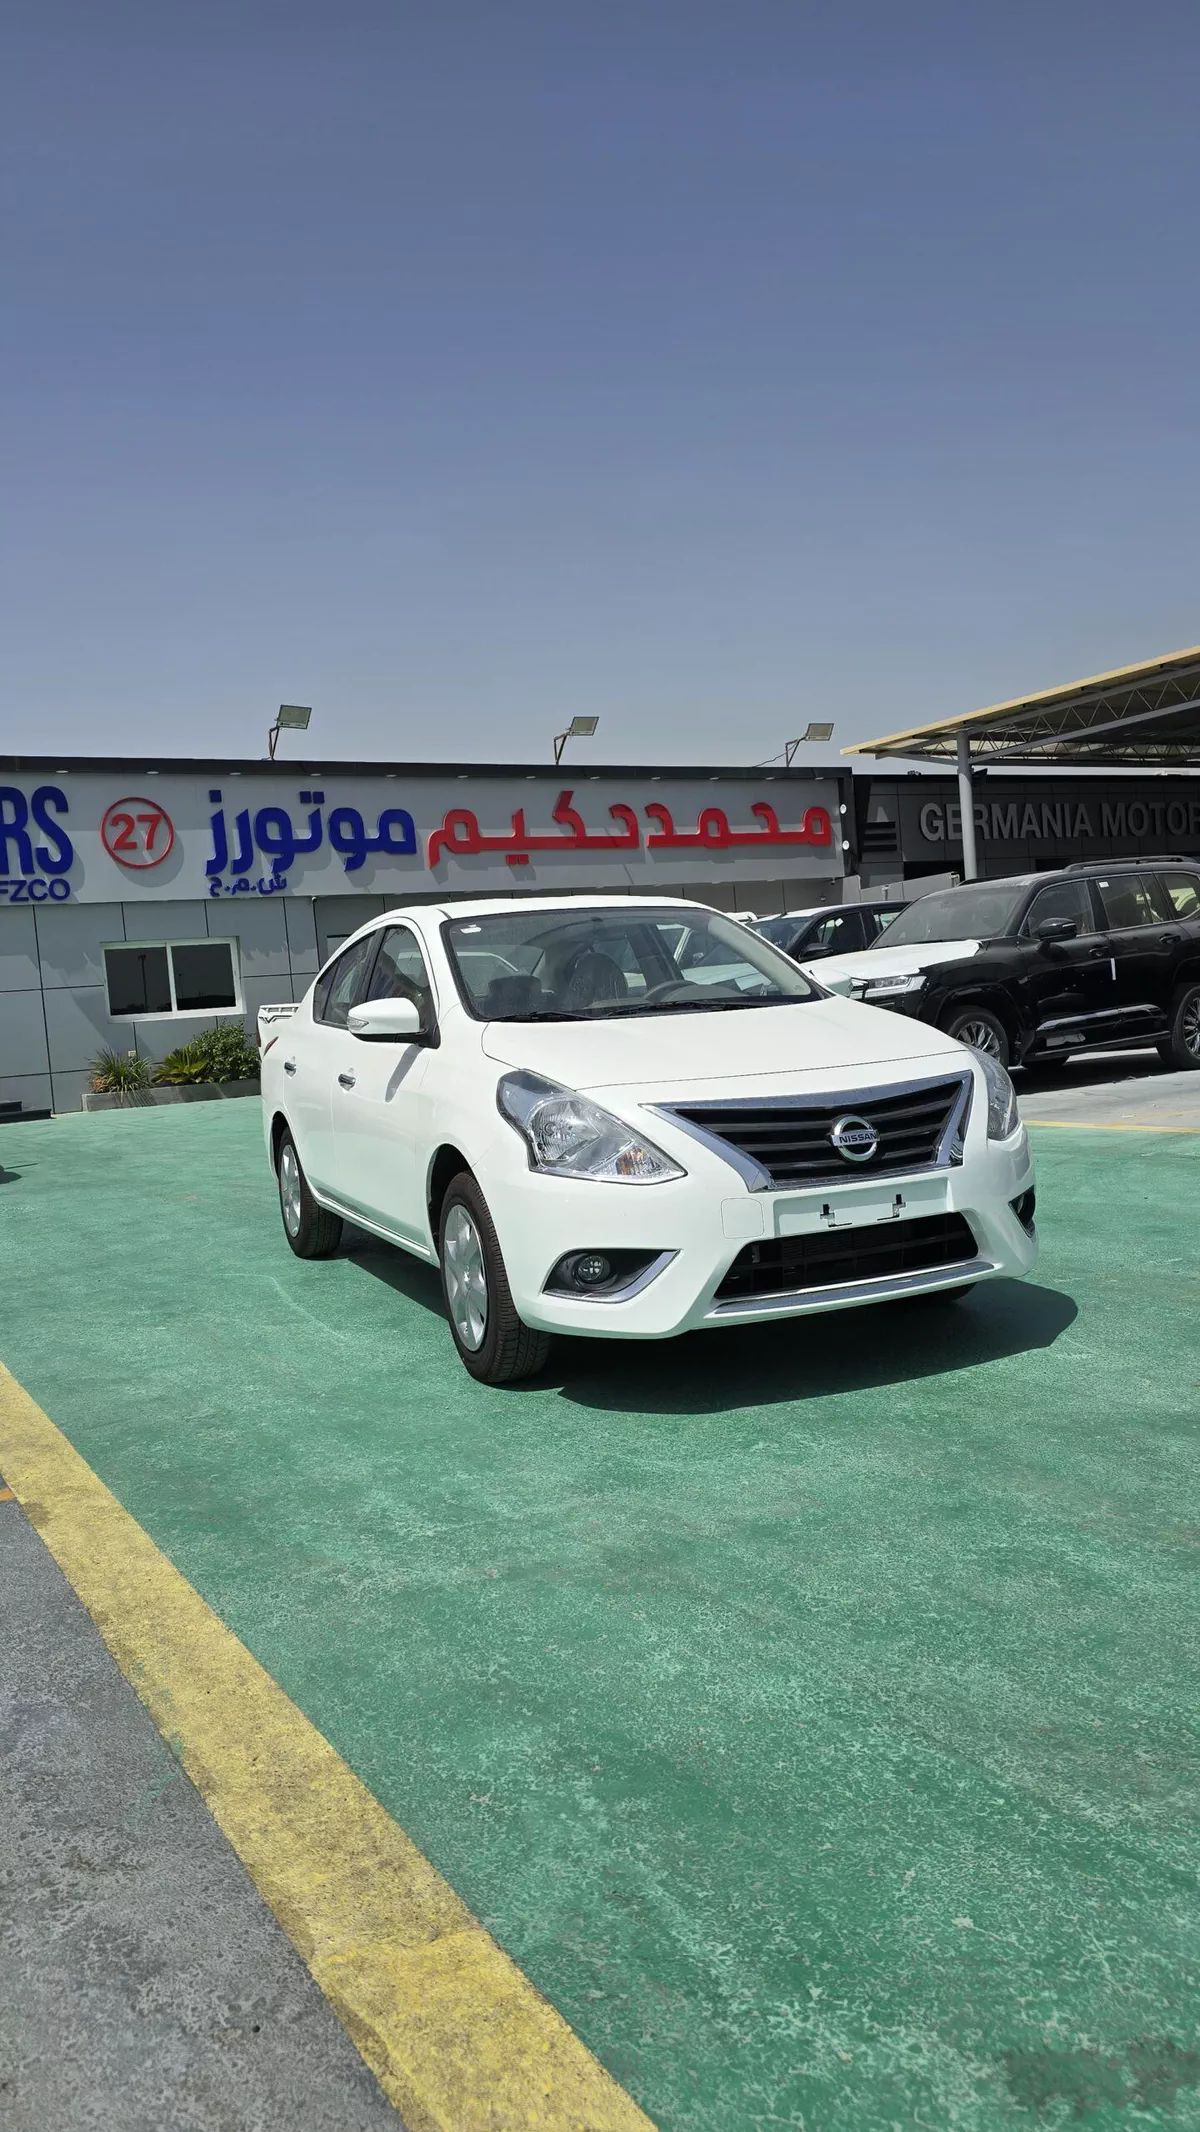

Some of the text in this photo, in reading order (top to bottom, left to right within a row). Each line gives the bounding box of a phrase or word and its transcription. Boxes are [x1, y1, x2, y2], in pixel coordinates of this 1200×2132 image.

[110, 813, 162, 850] 27
[205, 789, 832, 875] محمد حكيم موتورز
[920, 802, 1095, 841] GERMANIA
[839, 1132, 877, 1143] NISSAN
